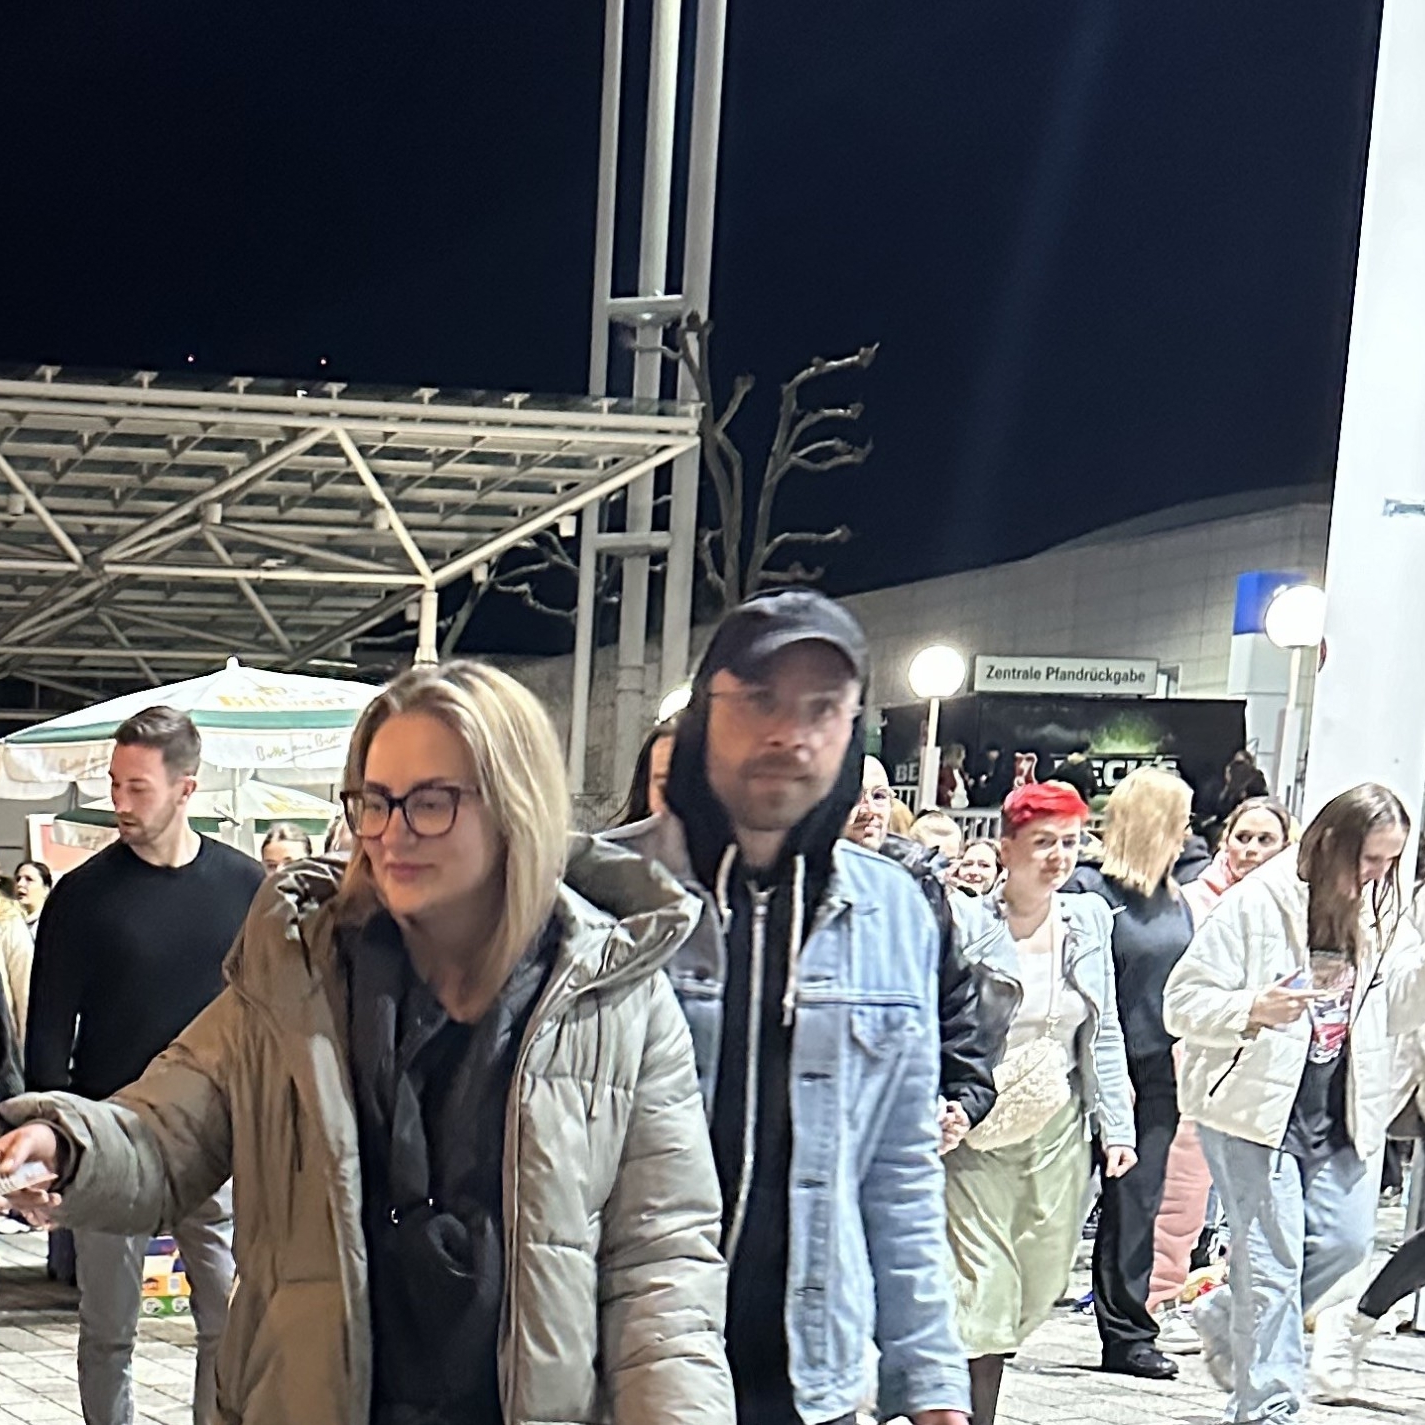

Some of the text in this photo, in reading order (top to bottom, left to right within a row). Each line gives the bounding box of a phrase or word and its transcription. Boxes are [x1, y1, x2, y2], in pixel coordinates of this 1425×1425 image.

[986, 664, 1146, 685] Zentrale Pfandrückgabe
[895, 762, 919, 782] BE
